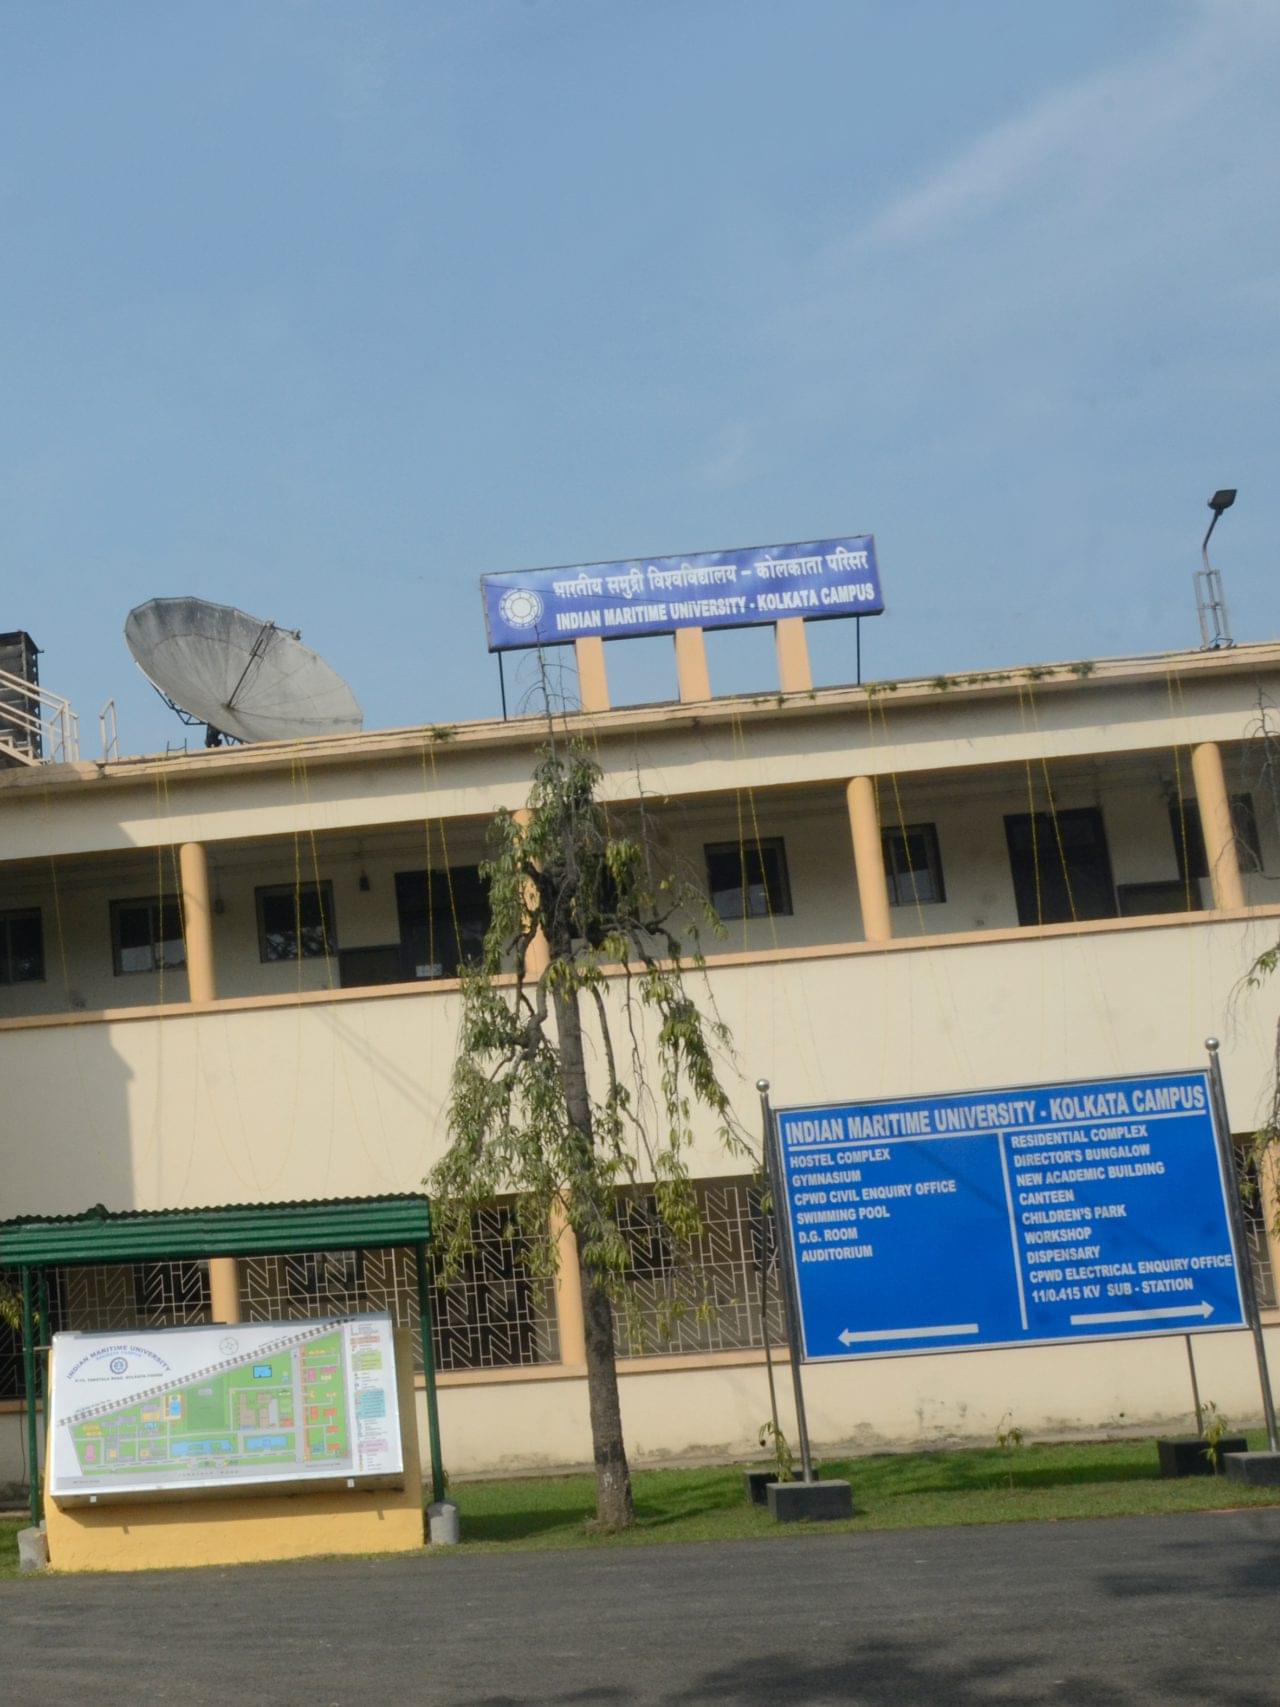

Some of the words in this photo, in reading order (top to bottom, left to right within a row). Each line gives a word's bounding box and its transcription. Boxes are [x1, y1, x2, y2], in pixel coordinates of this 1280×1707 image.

[552, 573, 602, 598] भारतीय
[605, 568, 643, 598] समुद्री
[648, 563, 736, 590] विश्वविद्यालय
[754, 554, 822, 579] कोलकाता
[825, 546, 868, 571] परिसर
[556, 610, 601, 630] INDIAN
[604, 603, 668, 626] MARITIME
[671, 597, 746, 619] UNIVERSITY
[757, 590, 818, 611] KOLKATA
[821, 583, 875, 604] CAMPUS
[785, 1118, 844, 1144] INDIAN
[848, 1111, 931, 1139] MARITIME
[935, 1101, 1036, 1131] UNIVERSITY
[1050, 1092, 1129, 1120] KOLKATA
[1132, 1085, 1204, 1112] CAMPUS
[1012, 1130, 1088, 1149] RESIDENTIAL
[1091, 1125, 1148, 1141] COMPLEX
[790, 1154, 834, 1168] HOSTEL
[837, 1149, 890, 1165] COMPLEX
[1014, 1150, 1082, 1168] DIRECTOR'S
[1086, 1144, 1150, 1160] BUNGALOW
[792, 1170, 861, 1187] GYMNASIUM
[1016, 1173, 1042, 1186] NEW
[1046, 1168, 1106, 1184] ACADEMIC
[1108, 1162, 1165, 1178] BUILDING
[794, 1192, 826, 1206] CPWD
[830, 1189, 859, 1204] CIVIL
[862, 1184, 912, 1201] ENQUIRY
[916, 1180, 956, 1195] OFFICE
[1019, 1189, 1074, 1206] CANTEEN
[797, 1208, 856, 1224] SWIMMING
[859, 1206, 890, 1219] POOL
[1022, 1207, 1092, 1225] CHILDREN'S
[1094, 1204, 1127, 1218] PARK
[799, 1230, 821, 1243] D.G.
[825, 1227, 858, 1241] ROOM
[1024, 1227, 1092, 1244] WORKSHOP
[802, 1245, 872, 1262] AUDITORIUM
[1027, 1246, 1100, 1264] DISPENSARY
[1030, 1268, 1062, 1284] CPWD
[1066, 1262, 1136, 1280] ELECTRICAL
[1138, 1258, 1190, 1276] ENQUIRY
[1190, 1254, 1233, 1270] OFFICE
[1032, 1286, 1080, 1303] 11/0.415
[1084, 1285, 1100, 1298] KV
[1107, 1282, 1132, 1296] SUB
[1142, 1278, 1194, 1294] STATION
[66, 1356, 90, 1380] INDIAN
[90, 1345, 128, 1359] MARITIME
[130, 1345, 171, 1372] UNIVERSITY
